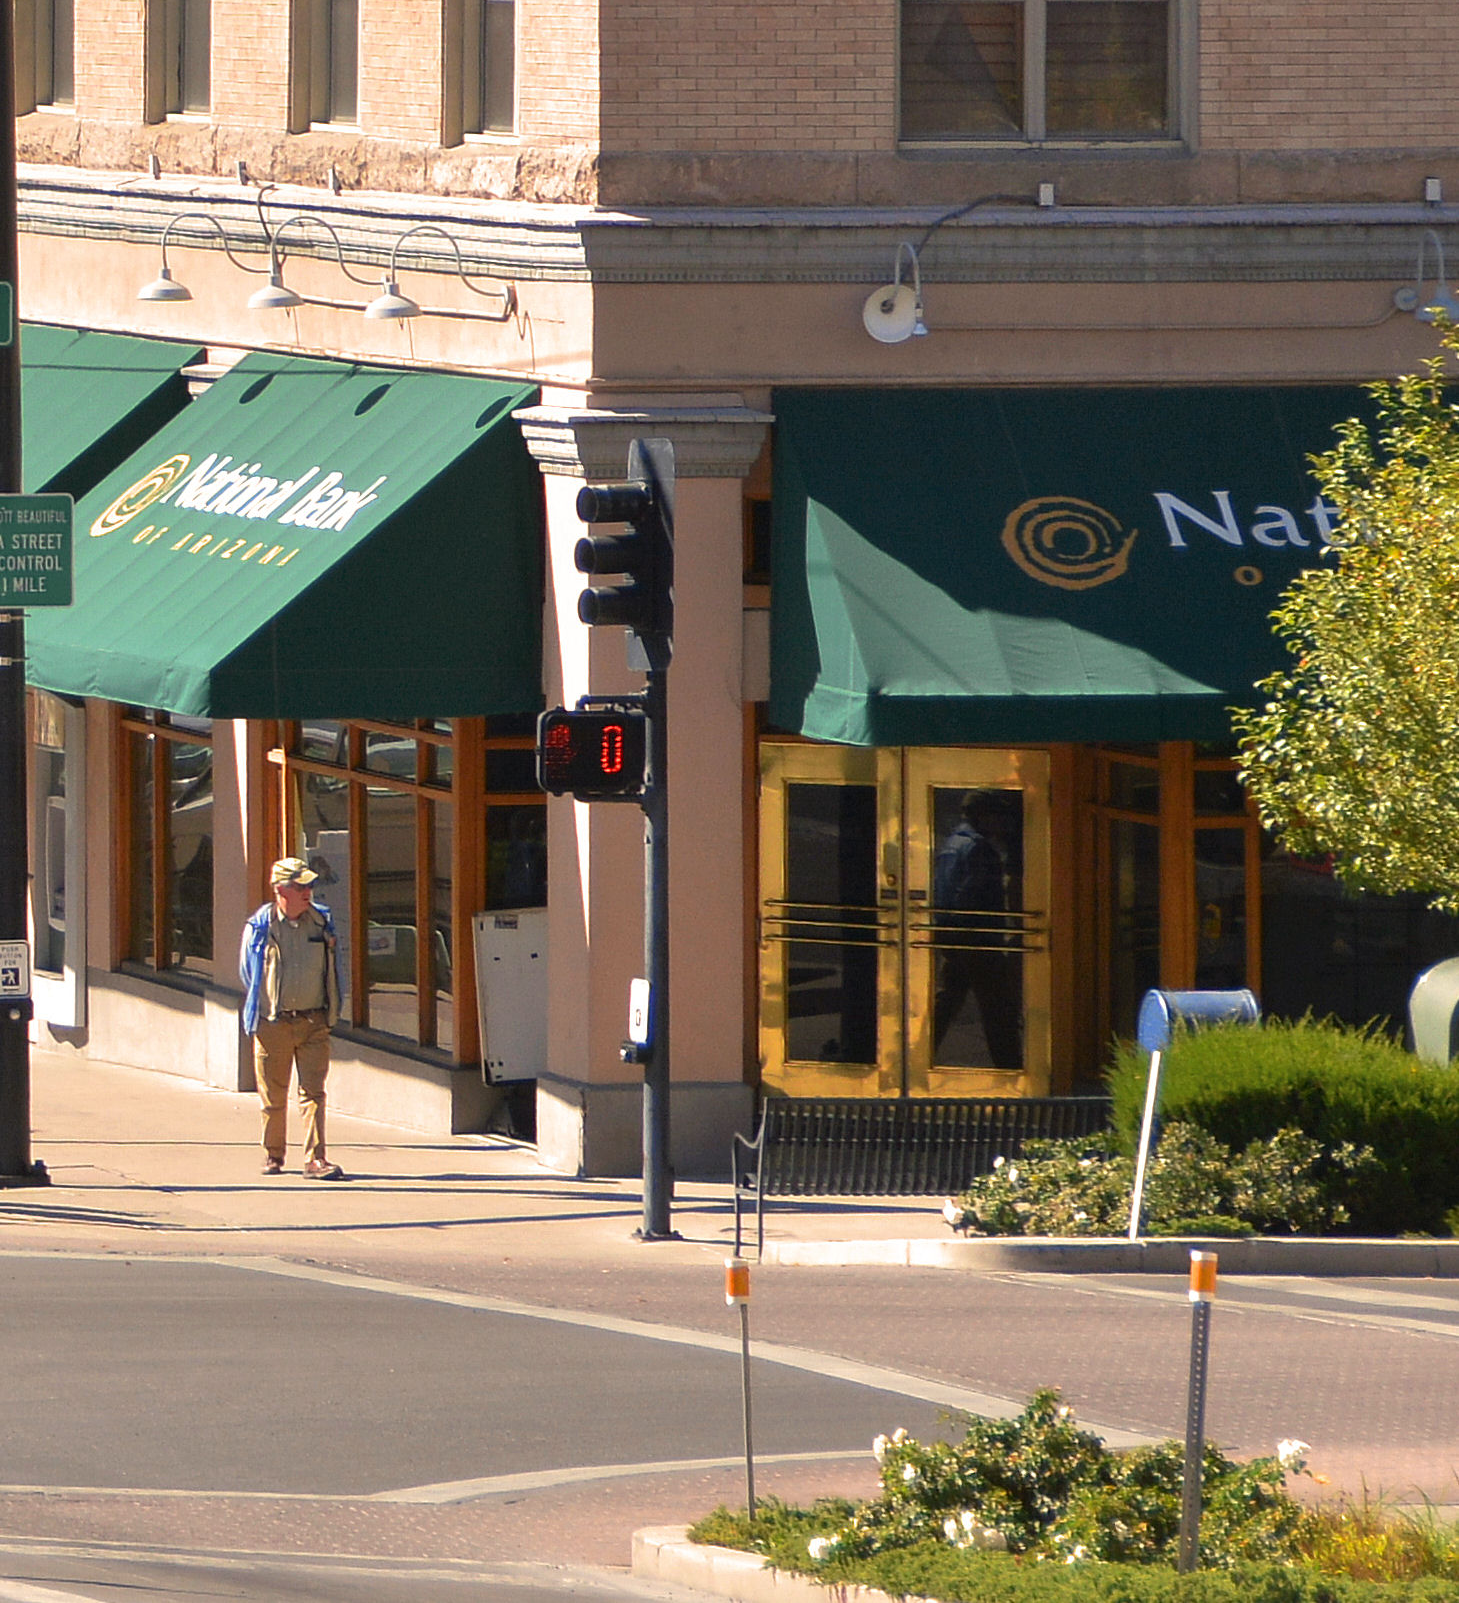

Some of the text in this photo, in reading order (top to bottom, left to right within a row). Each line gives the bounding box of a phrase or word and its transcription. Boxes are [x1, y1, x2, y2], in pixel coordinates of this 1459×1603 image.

[160, 453, 387, 531] National Bank
[17, 509, 67, 523] BEAUTIFUL
[11, 534, 63, 550] STREET
[132, 525, 299, 566] OF ARIZONA
[12, 577, 47, 593] MILE
[600, 724, 622, 774] 0
